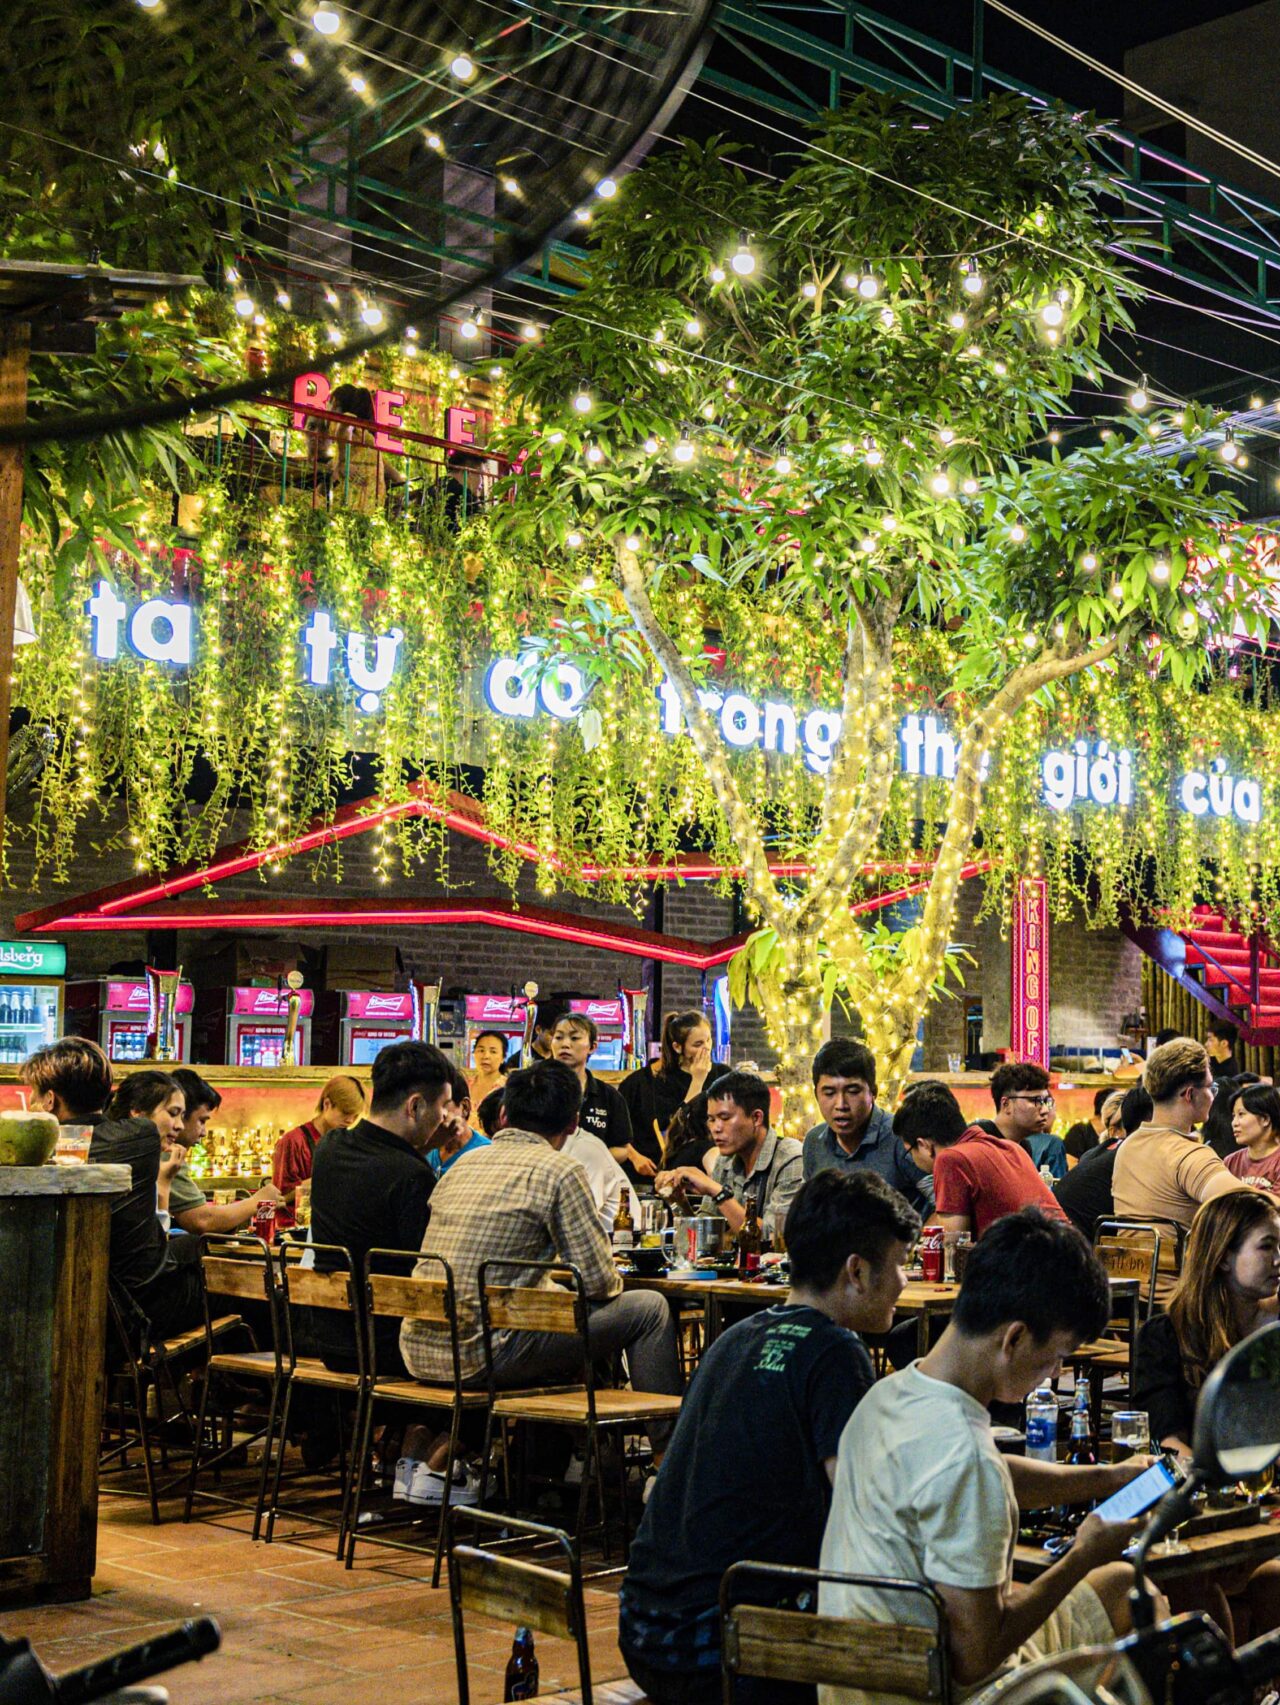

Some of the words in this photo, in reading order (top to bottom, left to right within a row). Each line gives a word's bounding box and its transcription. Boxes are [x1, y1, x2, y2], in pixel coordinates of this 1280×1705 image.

[85, 580, 192, 665] ta
[303, 610, 405, 713] tự
[1042, 739, 1132, 810] giới
[1180, 757, 1261, 822] của
[1025, 899, 1040, 1000] KING
[1025, 1005, 1040, 1057] OF
